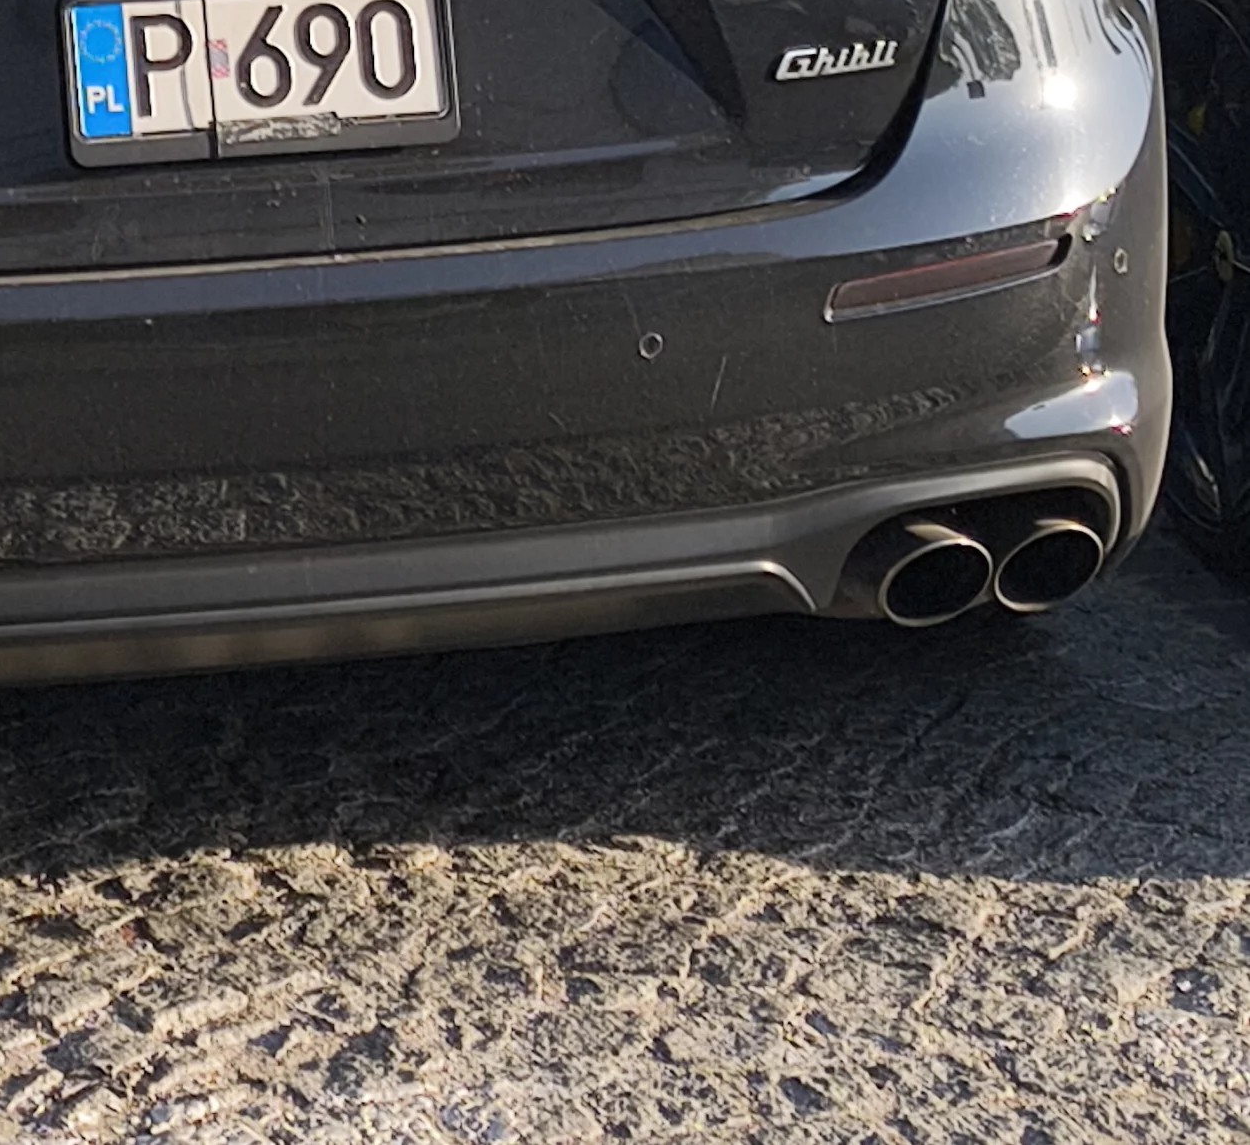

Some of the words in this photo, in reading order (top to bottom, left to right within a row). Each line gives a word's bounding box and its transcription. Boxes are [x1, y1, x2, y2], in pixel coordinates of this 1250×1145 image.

[129, 13, 193, 118] P
[775, 39, 899, 81] Ghibli
[85, 85, 125, 115] PL
